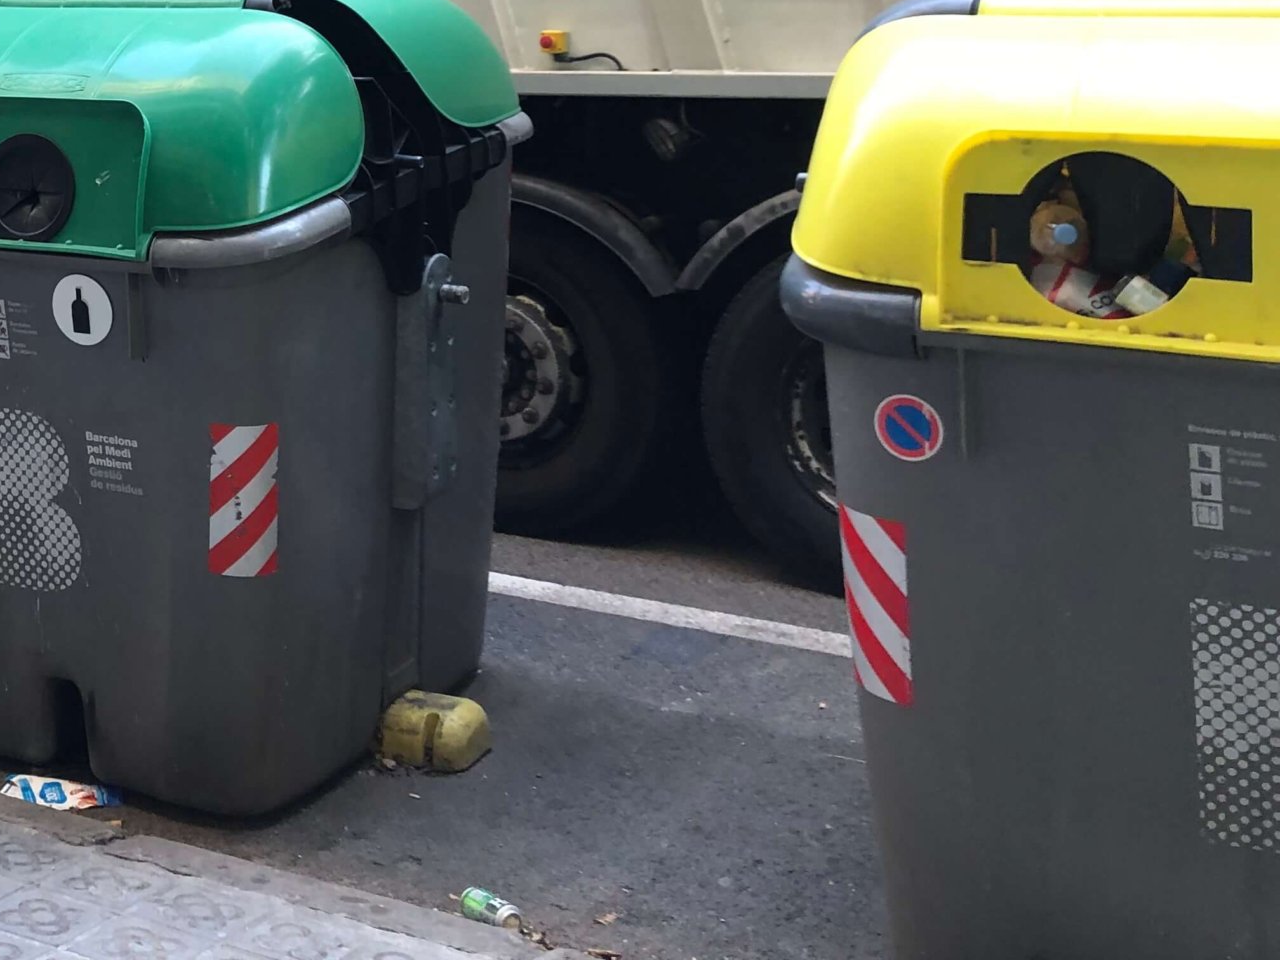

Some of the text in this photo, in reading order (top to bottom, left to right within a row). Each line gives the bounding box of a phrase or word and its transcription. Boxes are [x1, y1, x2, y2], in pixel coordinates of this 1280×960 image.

[85, 430, 138, 448] Barcelona
[86, 444, 132, 458] pel Medi
[88, 455, 133, 471] Ambient
[90, 478, 144, 496] de residus
